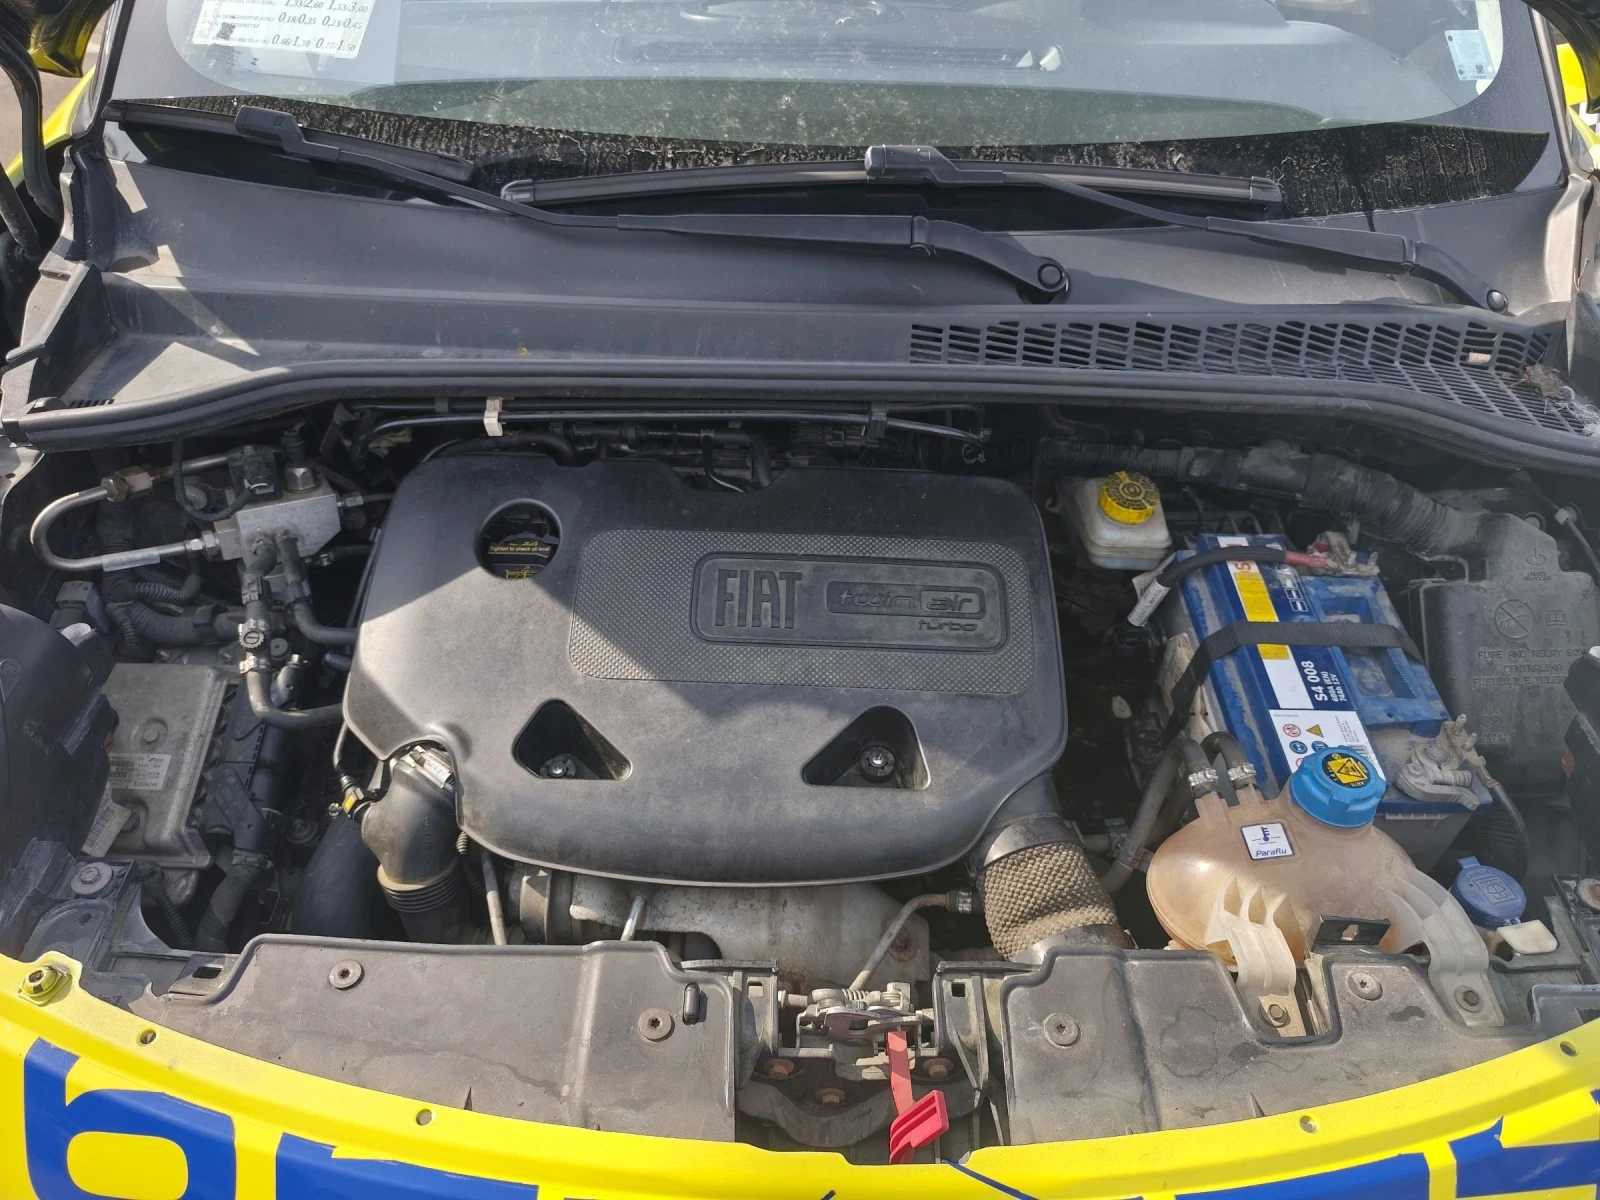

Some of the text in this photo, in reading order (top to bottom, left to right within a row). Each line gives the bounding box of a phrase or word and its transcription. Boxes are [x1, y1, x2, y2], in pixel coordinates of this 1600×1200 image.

[278, 12, 317, 25] 0,18/0,35
[322, 15, 363, 30] 0,23/0,45
[271, 34, 311, 48] 0,66/1,30
[714, 568, 803, 630] FIAT
[918, 618, 978, 632] turbo
[1477, 650, 1503, 659] FUSE
[1508, 650, 1526, 658] AND
[1531, 649, 1562, 658] RELAY
[1503, 664, 1563, 673] CENTRALINA
[1300, 660, 1328, 702] S4 008
[1256, 848, 1287, 858] Paraflu
